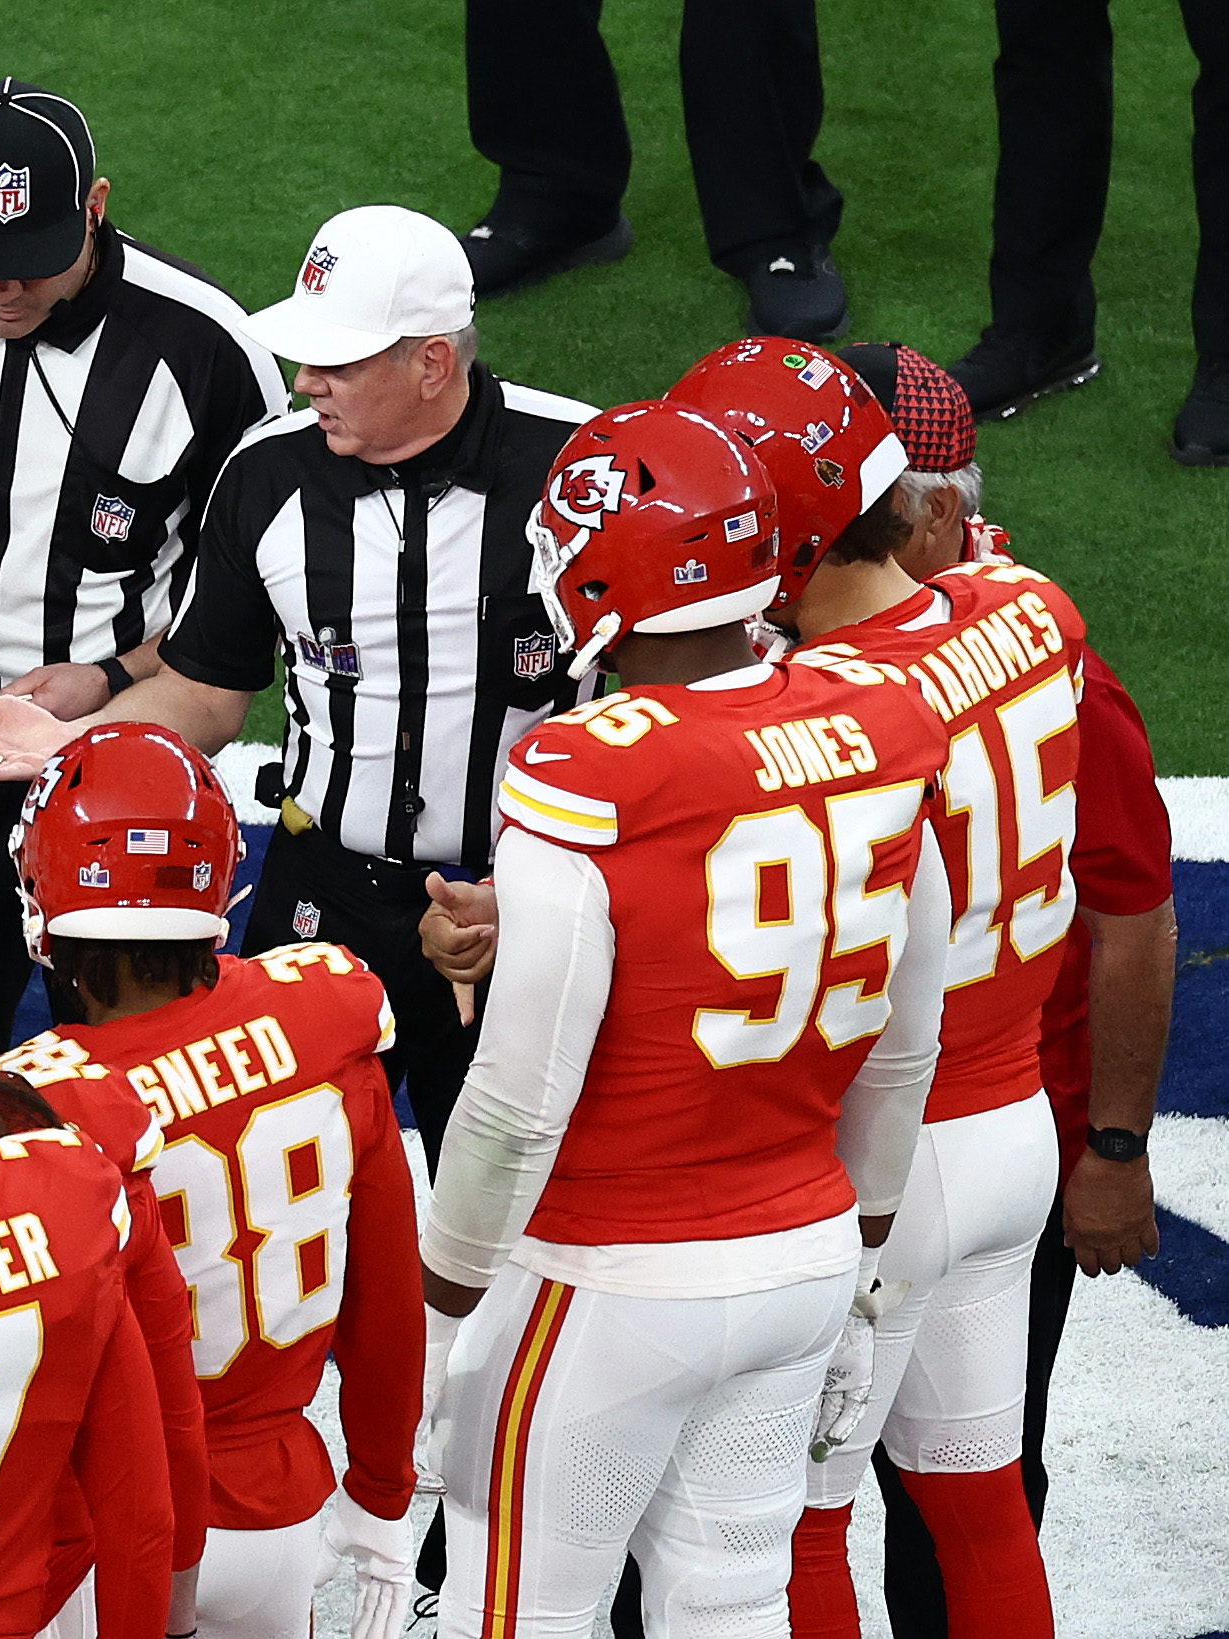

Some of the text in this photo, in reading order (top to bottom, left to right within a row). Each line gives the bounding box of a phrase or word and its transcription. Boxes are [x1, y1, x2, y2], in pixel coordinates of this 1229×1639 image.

[95, 511, 129, 537] NFL
[517, 650, 551, 674] NFL
[544, 692, 681, 747] 95
[744, 714, 878, 793] JONES
[942, 665, 1079, 993] 15
[294, 914, 319, 936] NFL
[692, 778, 926, 1070] 95
[126, 1014, 298, 1128] SNEED
